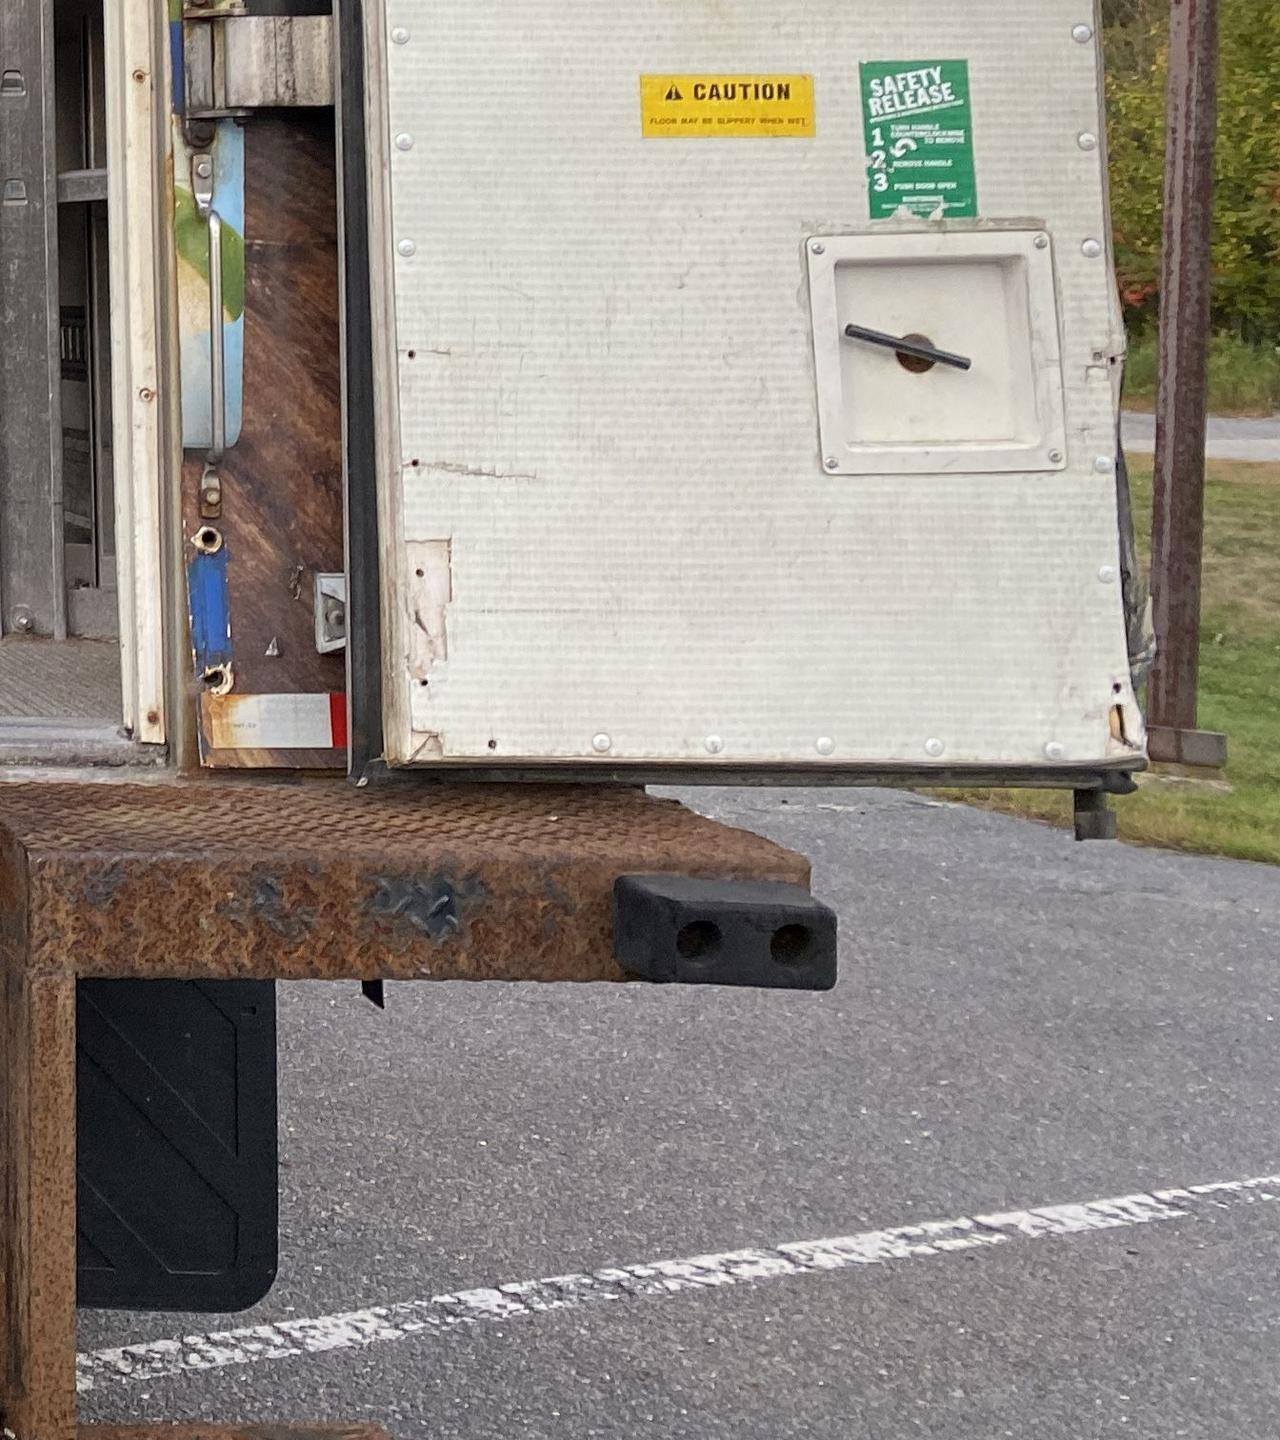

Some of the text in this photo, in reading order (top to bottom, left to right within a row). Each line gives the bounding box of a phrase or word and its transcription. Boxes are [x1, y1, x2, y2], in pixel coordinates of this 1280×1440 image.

[870, 65, 942, 97] SAFETY
[693, 83, 790, 100] CAUTION
[868, 82, 956, 116] RELEASE
[649, 117, 677, 125] FLOOR
[717, 117, 756, 125] SLIPPERY
[759, 117, 784, 125] WHEN
[872, 127, 884, 146] 1
[871, 150, 886, 168] 2
[873, 172, 888, 192] 3
